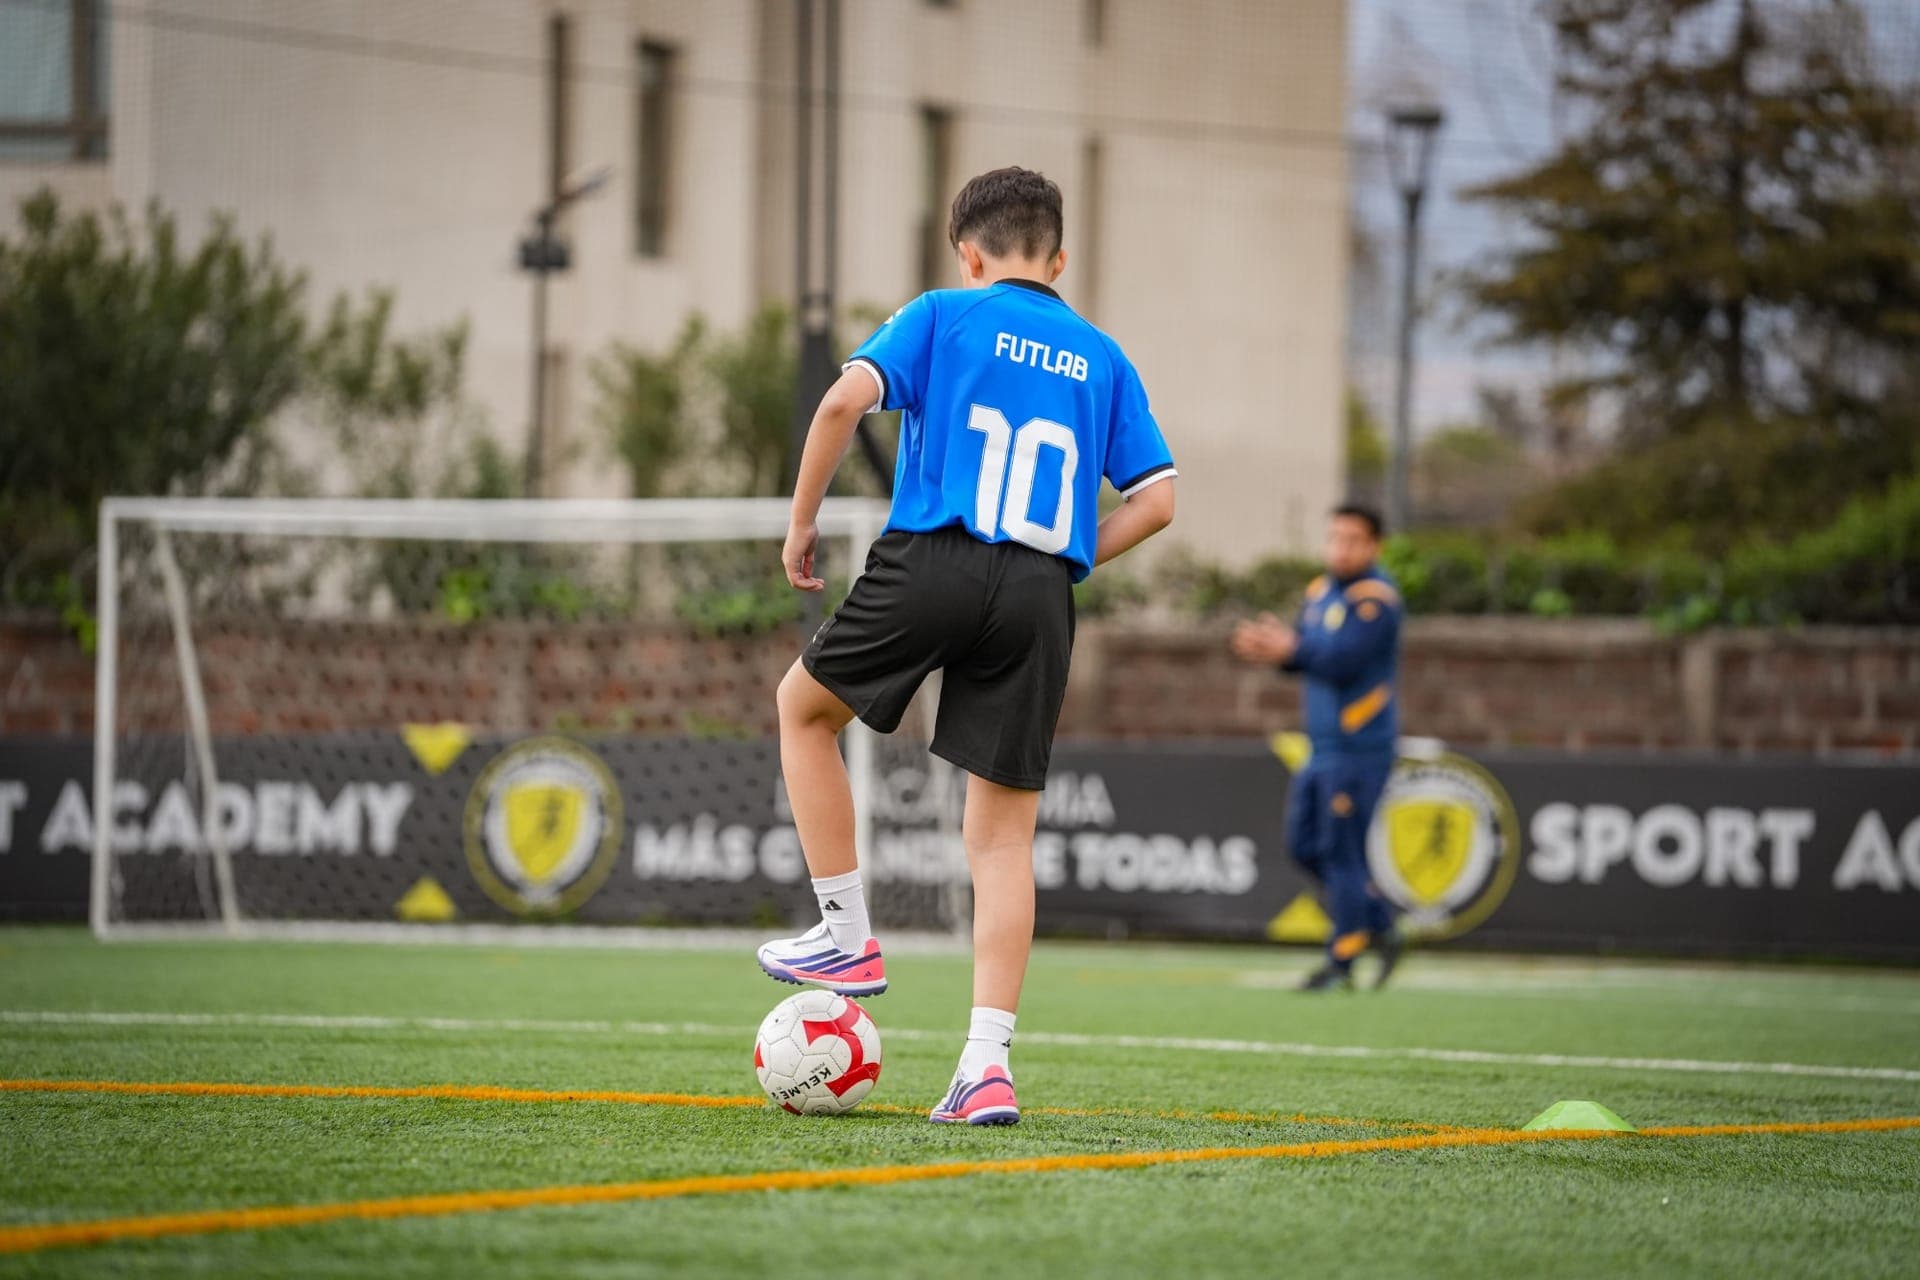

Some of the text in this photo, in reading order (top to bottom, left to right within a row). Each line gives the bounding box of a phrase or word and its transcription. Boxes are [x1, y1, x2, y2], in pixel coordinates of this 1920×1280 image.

[995, 332, 1088, 382] FUTLAB
[967, 403, 1079, 554] 10
[41, 780, 413, 855] ACADEMY
[633, 811, 755, 882] MÁS
[1070, 832, 1258, 894] TODAS
[1529, 803, 1816, 887] SPORT
[780, 1067, 832, 1100] KELME
